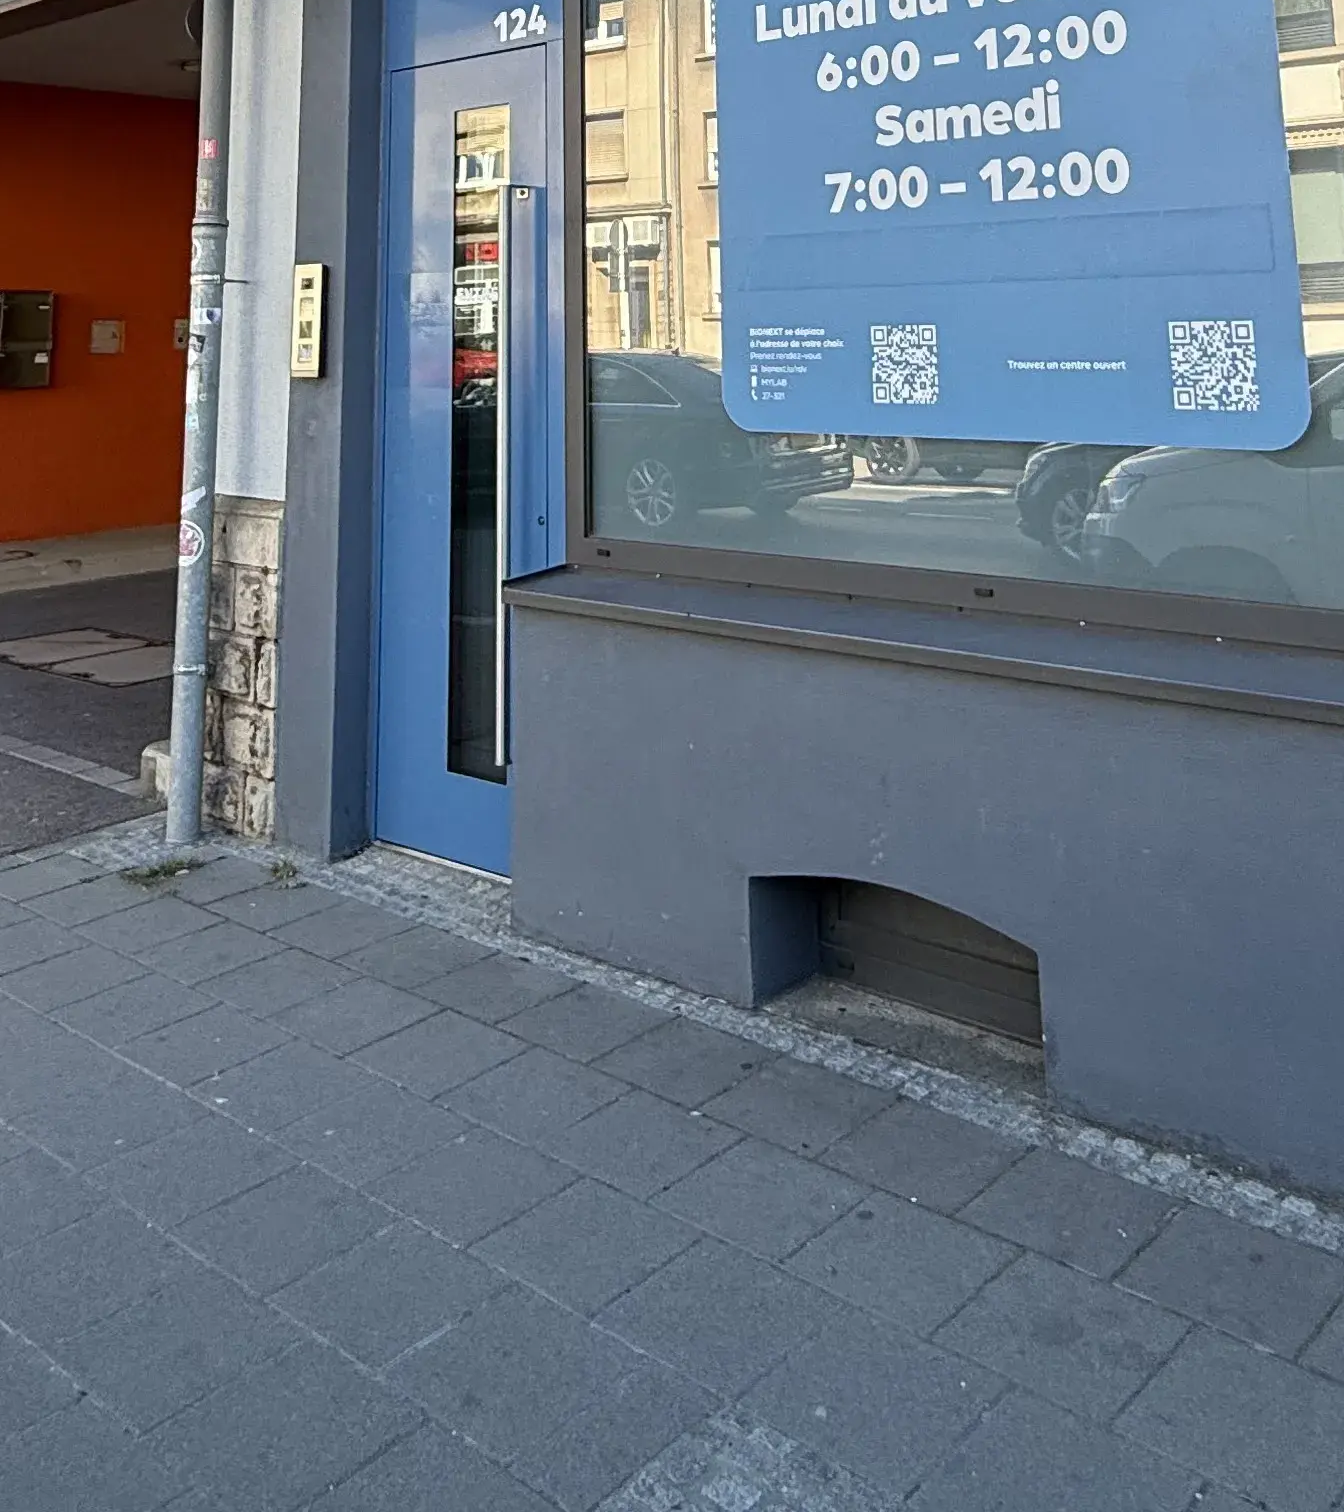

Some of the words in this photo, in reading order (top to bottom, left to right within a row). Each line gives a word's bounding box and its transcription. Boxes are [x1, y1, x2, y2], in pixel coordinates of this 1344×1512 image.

[493, 4, 547, 43] 124
[816, 40, 921, 92] 6:00
[973, 9, 1127, 70] 12:00
[875, 79, 1061, 147] Samedi
[824, 165, 929, 214] 7:00
[978, 148, 1130, 203] 12:00
[1007, 360, 1045, 370] Trouvez
[1047, 361, 1058, 369] un
[1060, 360, 1091, 370] centre
[1093, 360, 1127, 370] ouvert
